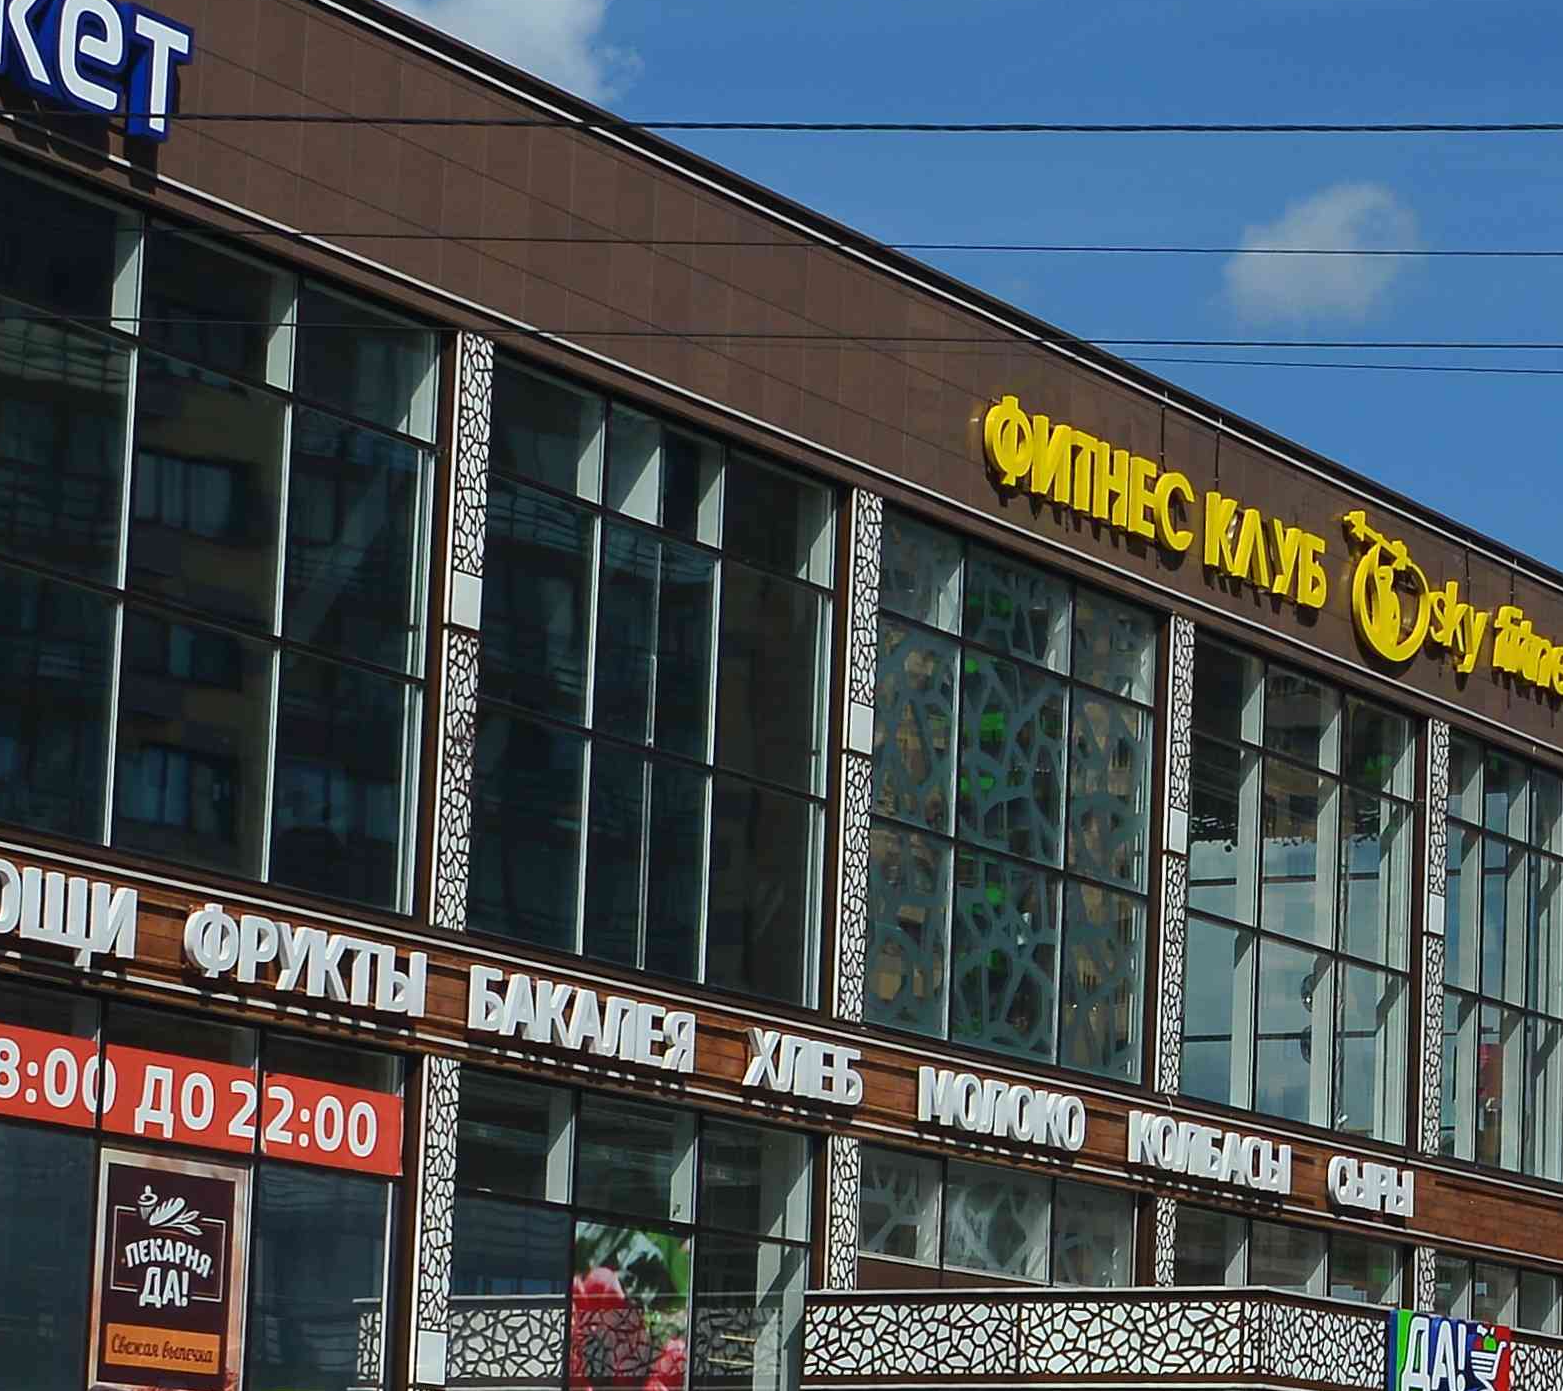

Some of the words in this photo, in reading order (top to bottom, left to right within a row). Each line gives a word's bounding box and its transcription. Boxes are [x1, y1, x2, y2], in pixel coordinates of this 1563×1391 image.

[983, 394, 1195, 552] ФИТНЕС
[1203, 490, 1328, 609] КЛУБ
[1429, 579, 1488, 674] sky
[182, 902, 427, 1018] ФРУКТЫ
[467, 964, 696, 1073] БАКАЛЕЯ
[742, 1027, 864, 1106] ХЛЕБ
[917, 1065, 1086, 1152] МОЛОКО
[1127, 1110, 1292, 1195] КОЛБАСЫ
[1327, 1155, 1415, 1218] СЫРЫ
[134, 1067, 215, 1140] ДО
[228, 1079, 377, 1158] 22:00
[124, 1238, 213, 1280] ПЕКАРНЯ
[138, 1266, 190, 1308] ДА!
[110, 1334, 157, 1359] Свежая
[160, 1340, 215, 1364] выпечка
